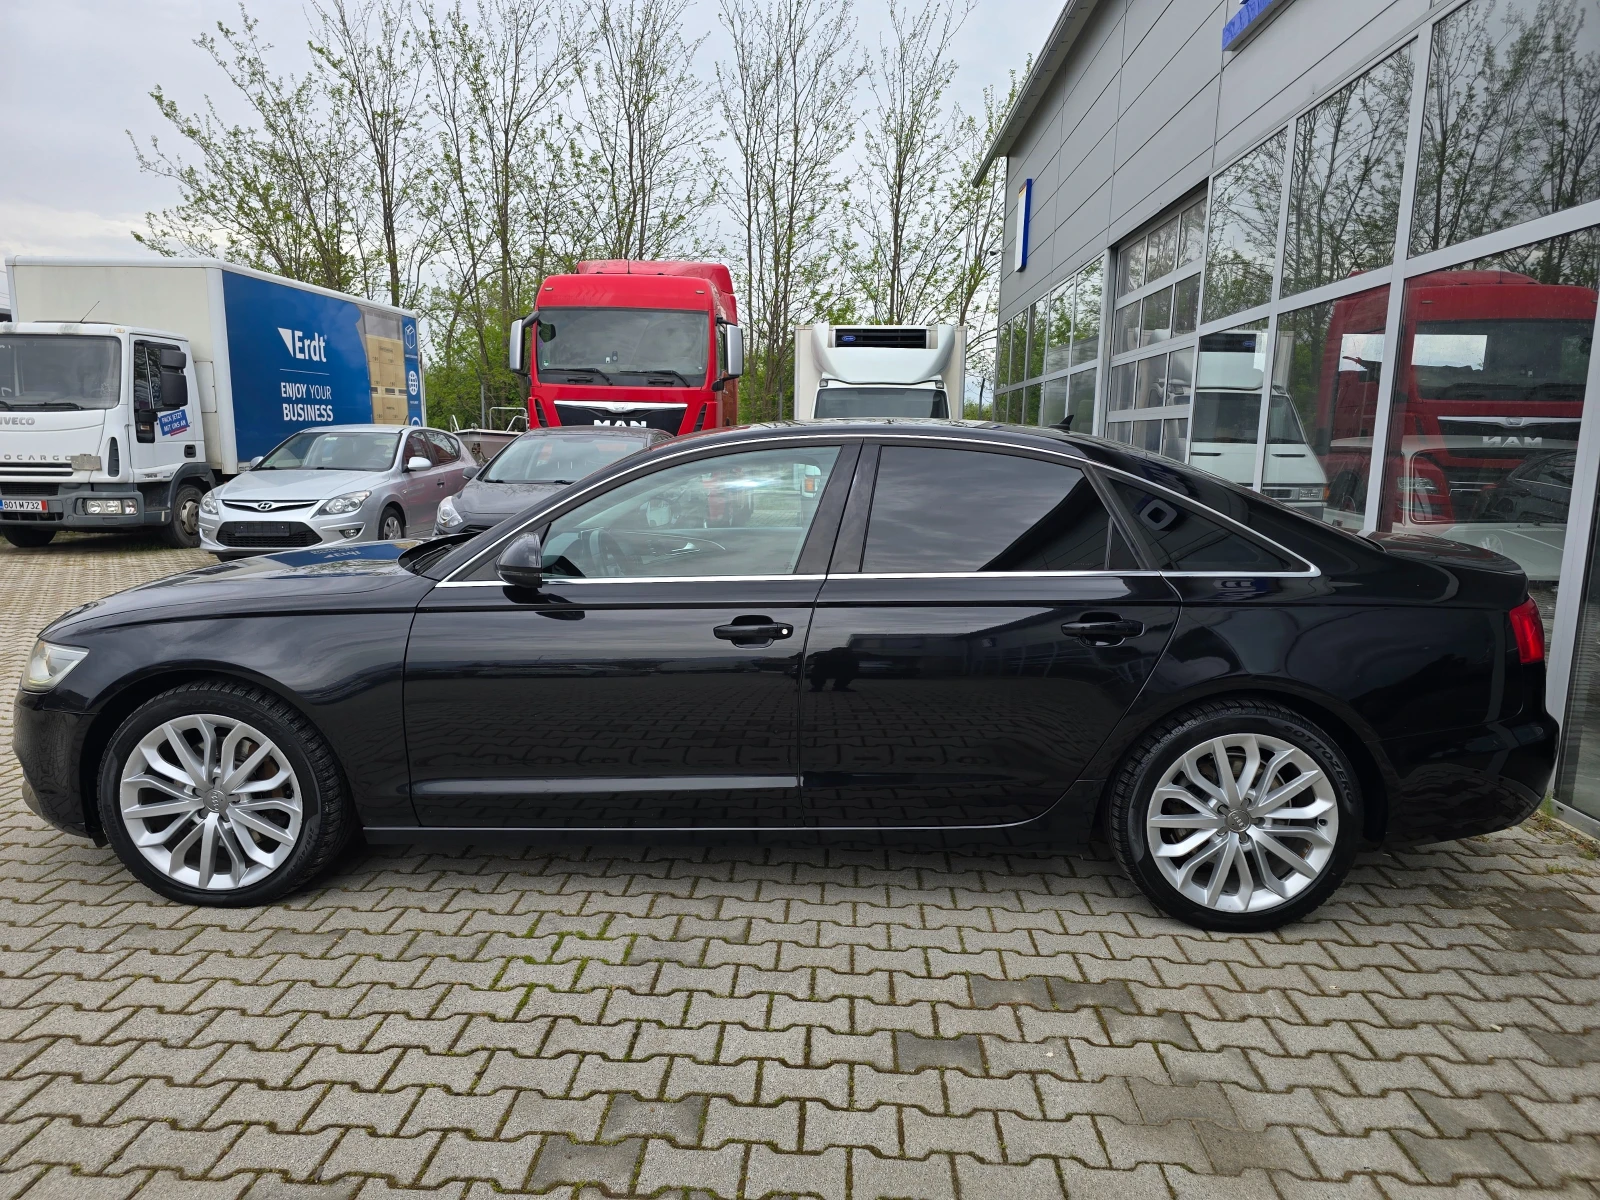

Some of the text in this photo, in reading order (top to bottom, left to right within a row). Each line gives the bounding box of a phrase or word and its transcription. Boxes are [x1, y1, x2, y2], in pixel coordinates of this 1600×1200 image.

[294, 330, 327, 363] Erdt
[280, 382, 332, 400] ENJOY YOUR
[282, 403, 334, 422] BUSINESS
[593, 419, 647, 428] MAN
[1283, 725, 1355, 804] SOTTOZERO
